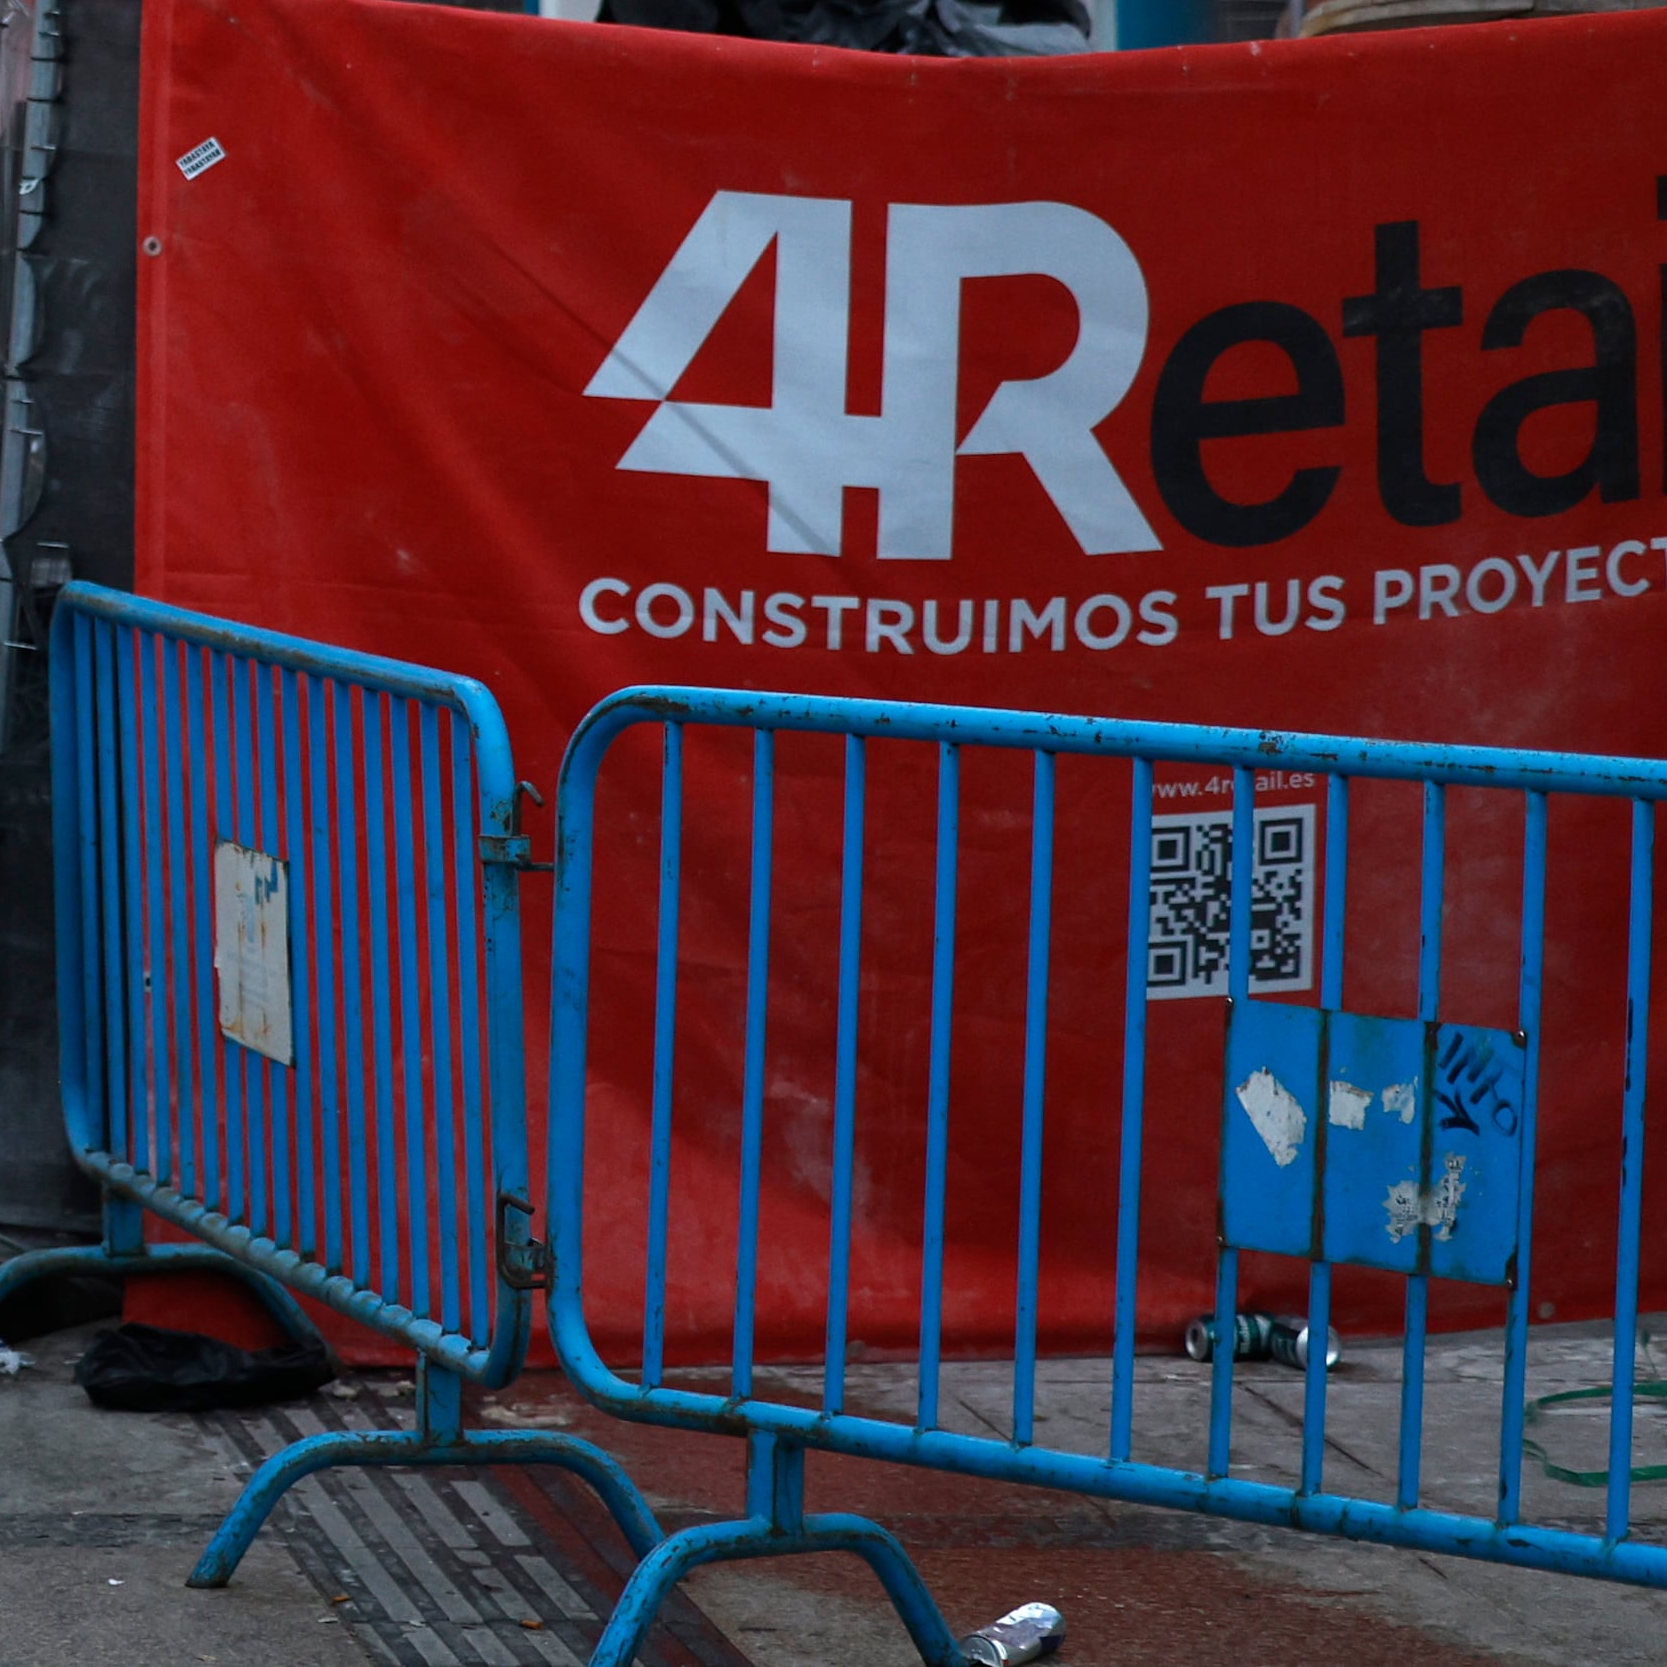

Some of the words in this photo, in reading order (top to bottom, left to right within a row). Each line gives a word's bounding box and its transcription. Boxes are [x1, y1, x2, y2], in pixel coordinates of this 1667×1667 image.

[581, 175, 1667, 560] 4Reta
[578, 577, 1178, 655] CONSTRUIMOS
[1205, 575, 1346, 640] TUS
